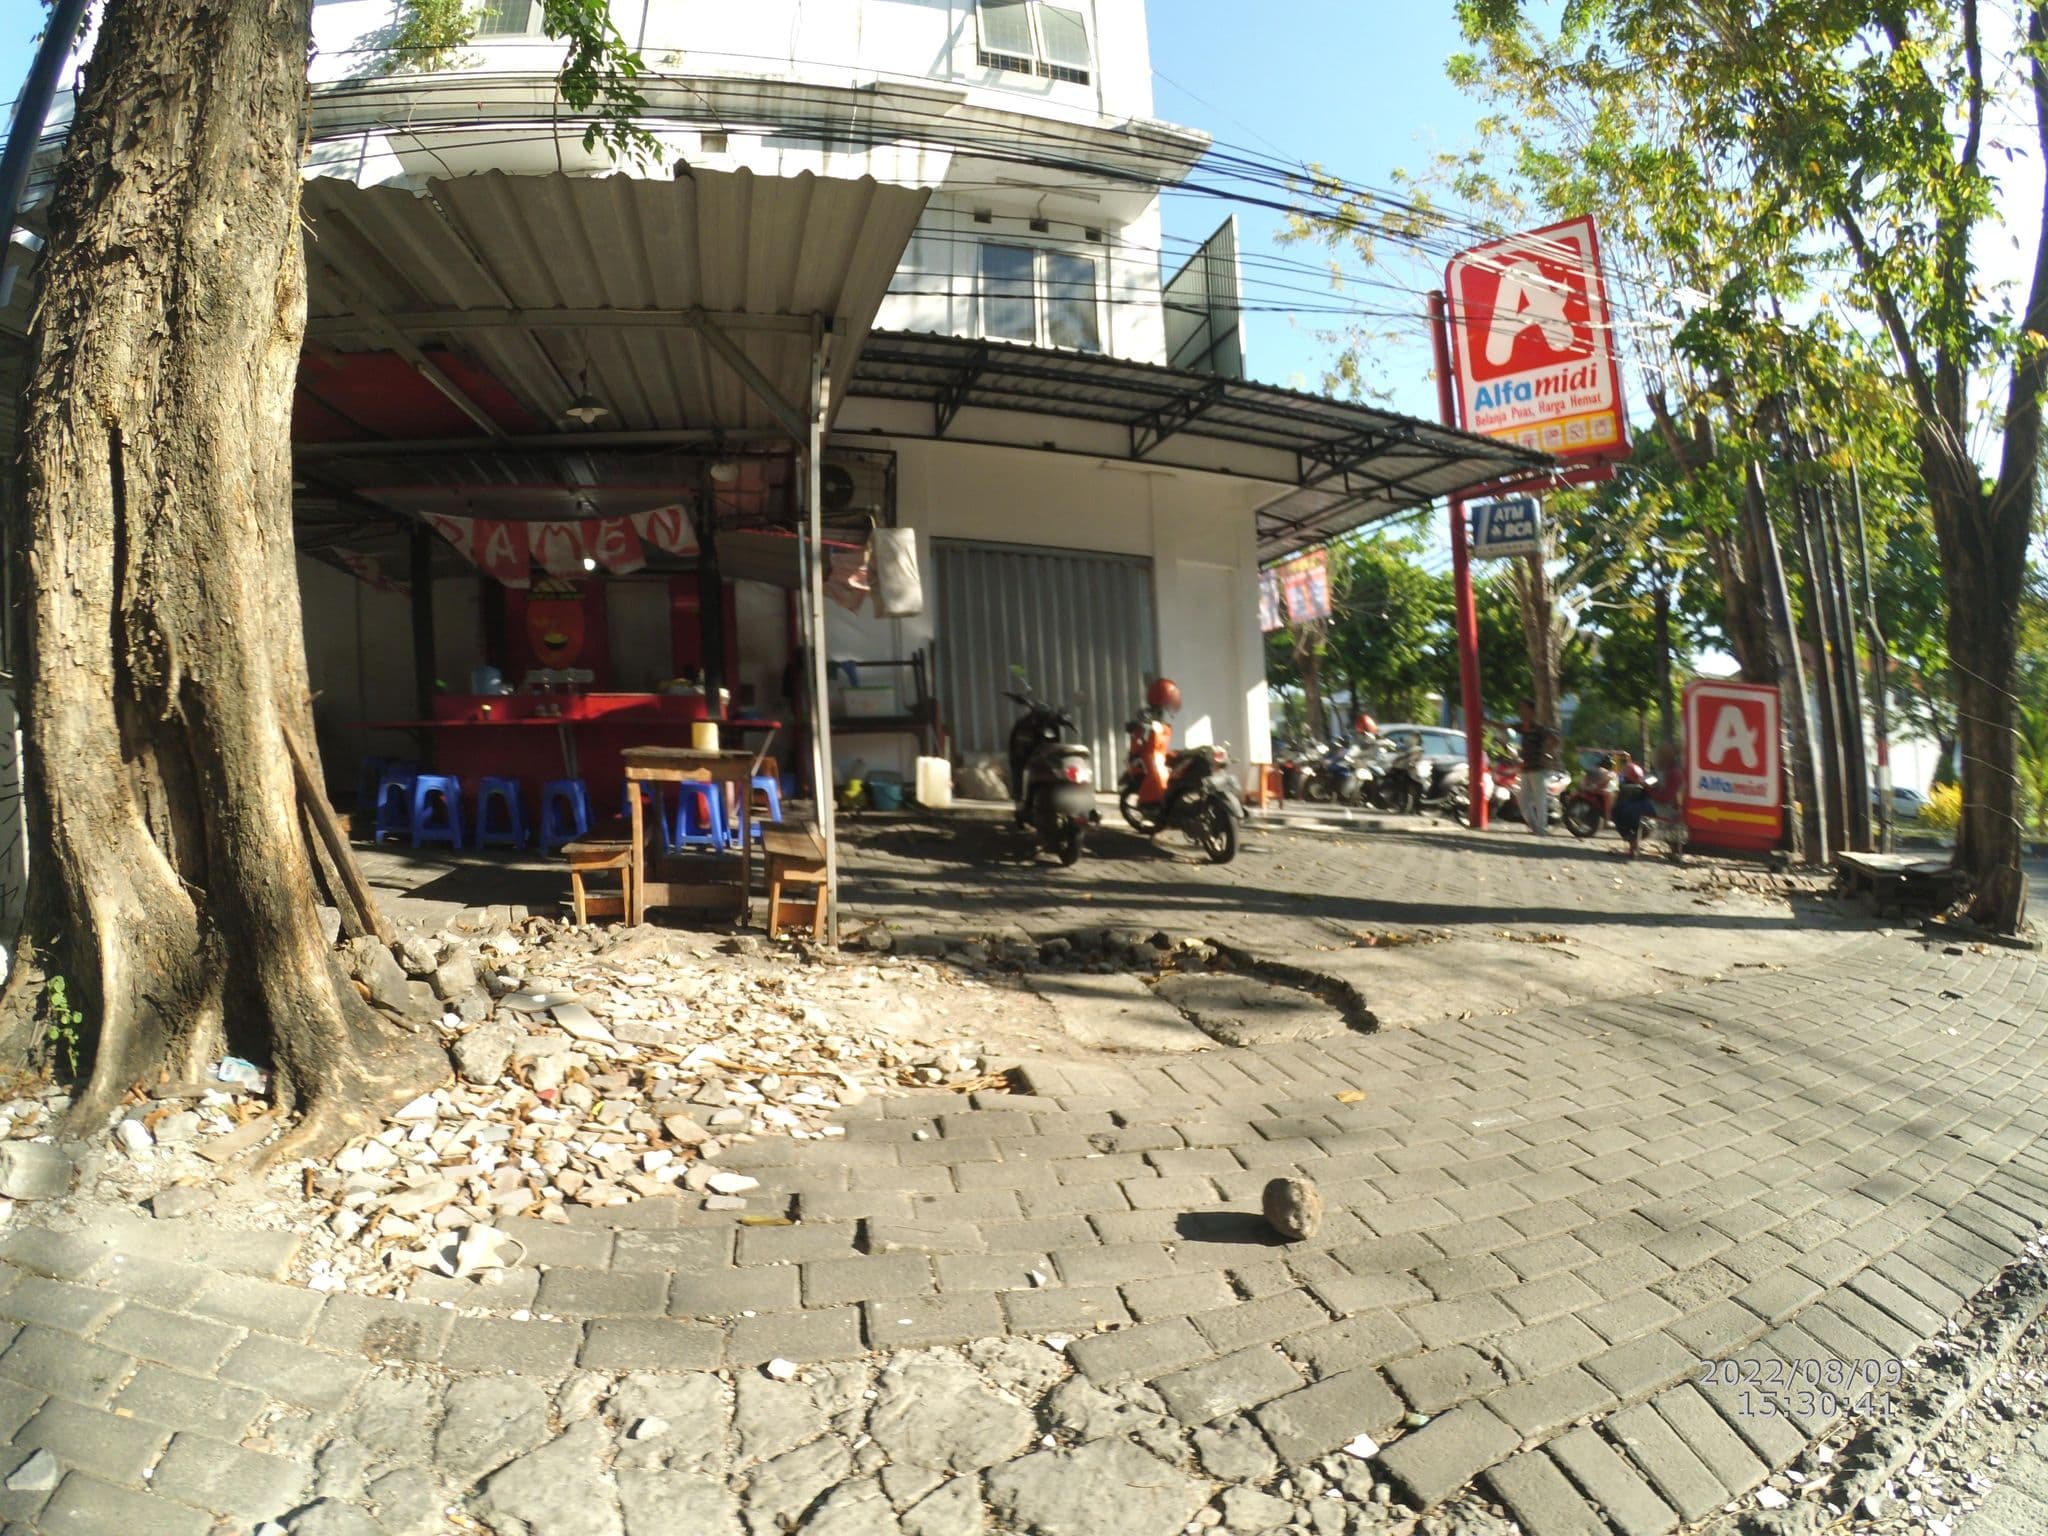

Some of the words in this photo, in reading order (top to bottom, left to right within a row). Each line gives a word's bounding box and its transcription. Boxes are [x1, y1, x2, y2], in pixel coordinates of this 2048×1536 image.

[1474, 363, 1597, 411] Alfamidi
[1539, 400, 1566, 415] Harga
[1570, 393, 1601, 407] Hemat
[1494, 505, 1524, 521] ATM
[1505, 521, 1533, 537] BCA
[1706, 704, 1759, 768] A
